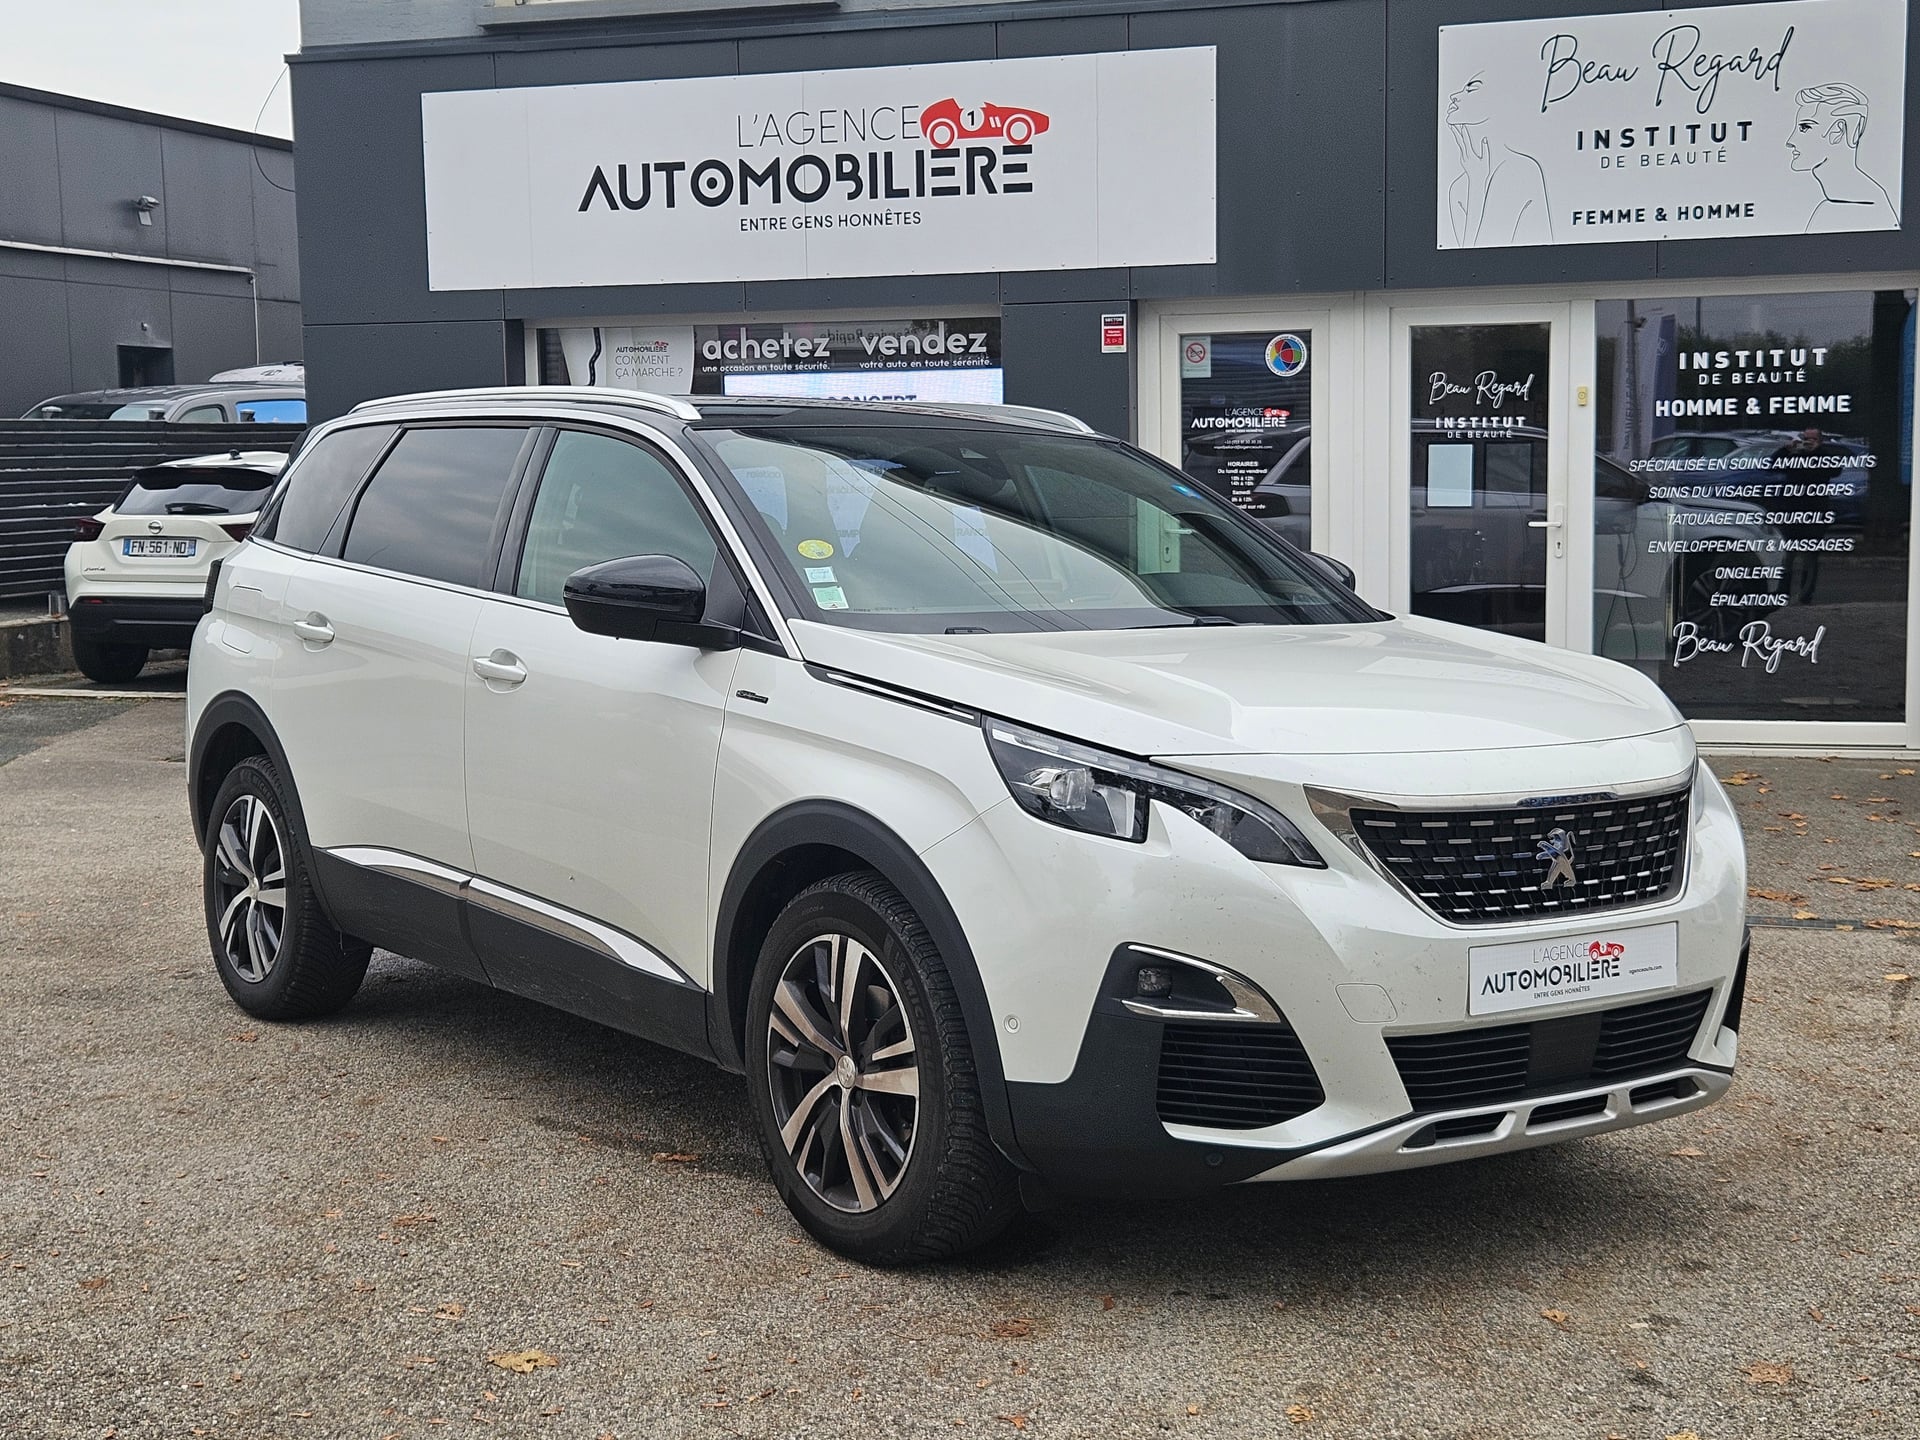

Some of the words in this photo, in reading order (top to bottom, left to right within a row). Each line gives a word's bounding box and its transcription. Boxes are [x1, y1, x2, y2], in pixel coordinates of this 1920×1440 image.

[1540, 34, 1638, 113] Beau
[1652, 24, 1794, 115] Regard
[736, 105, 919, 150] L'AGENCE
[1577, 120, 1753, 151] INSTITUT
[1600, 155, 1625, 169] DE
[1640, 147, 1728, 167] BEAUTÉ
[739, 214, 787, 232] ENTRE
[791, 212, 834, 230] GENS
[837, 208, 922, 228] HONNÊTES
[1572, 206, 1646, 226] FEMME
[1655, 206, 1668, 222] &
[1677, 203, 1756, 221] HOMME
[702, 327, 831, 360] achetez
[859, 321, 988, 356] vendez
[614, 355, 671, 366] COMMENT
[702, 365, 718, 373] une
[719, 363, 755, 373] occasion
[770, 362, 793, 371] toute
[859, 360, 884, 369] votre
[886, 360, 908, 368] auto
[924, 359, 950, 367] toute
[1679, 347, 1828, 371] INSTITUT
[614, 367, 629, 379] ÇA
[631, 367, 675, 377] MARCHE
[677, 367, 684, 377] ?
[1698, 373, 1721, 386] DE
[1731, 369, 1808, 385] BEAUTÉ
[1428, 371, 1472, 405] Beau
[1474, 371, 1535, 409] Regard
[1225, 408, 1264, 416] L'AGENCE
[1655, 398, 1738, 417] HOMME
[1746, 398, 1761, 415] &
[1769, 394, 1852, 414] FEMME
[1435, 416, 1527, 428] INSTITUT
[1467, 428, 1513, 438] BEAUTÉ
[1628, 456, 1705, 472] SPÉCIALISÉ
[1707, 458, 1727, 471] EN
[1729, 457, 1771, 470] SOINS
[1772, 455, 1877, 469] AMINCISSANTS
[1648, 486, 1691, 499] SOINS
[1691, 485, 1712, 498] DU
[1714, 485, 1762, 497] VISAGE
[1763, 485, 1782, 497] ET
[1783, 484, 1805, 497] DU
[1806, 483, 1854, 496] CORPS
[1668, 513, 1735, 525] TATOUAGE
[1735, 512, 1765, 525] DES
[1765, 511, 1835, 524] SOURCILS
[1647, 540, 1765, 553] ENVELOPPEMENT
[1765, 540, 1775, 552] &
[1778, 538, 1855, 552] MASSAGES
[1714, 566, 1785, 579] ONGLERIE
[1709, 592, 1789, 607] ÉPILATIONS
[1672, 621, 1734, 668] Beau
[1739, 620, 1826, 673] Regard
[1533, 942, 1589, 964] L'AGENCE
[1533, 991, 1549, 999] ENTRE
[1549, 989, 1564, 997] GENS
[1564, 985, 1591, 995] HONNÊTES
